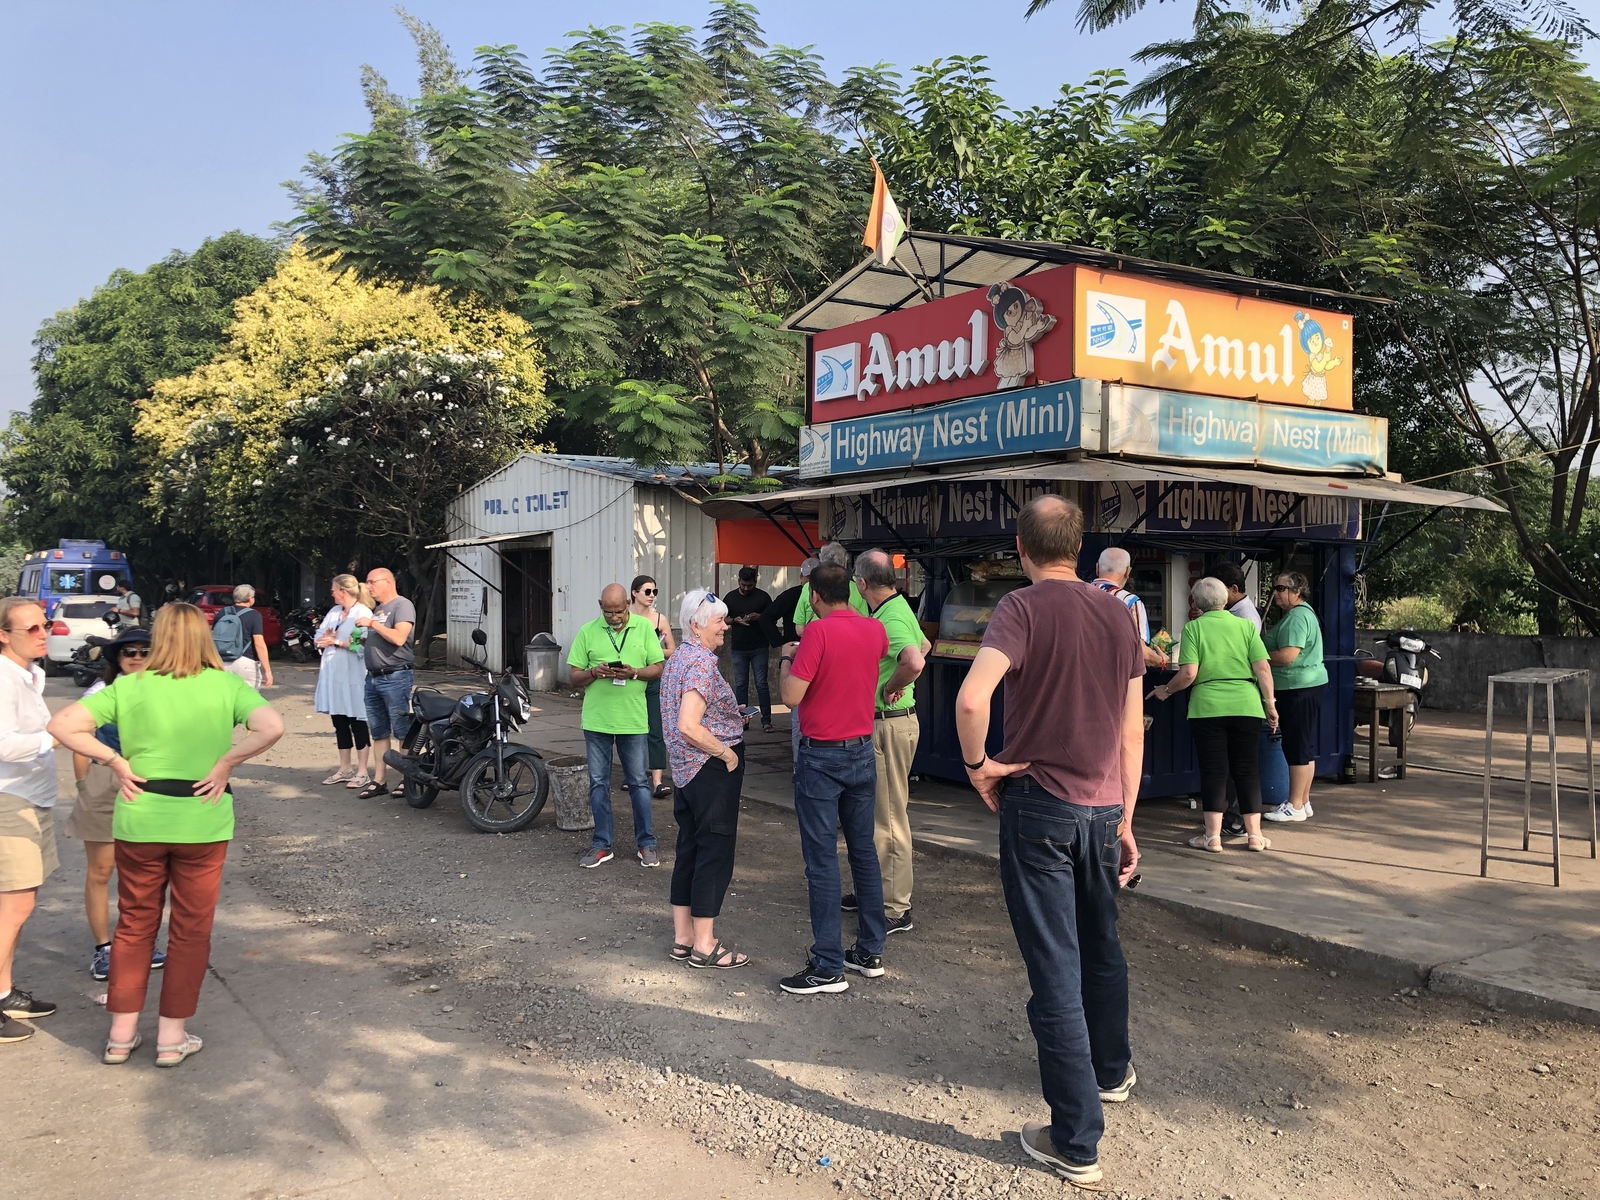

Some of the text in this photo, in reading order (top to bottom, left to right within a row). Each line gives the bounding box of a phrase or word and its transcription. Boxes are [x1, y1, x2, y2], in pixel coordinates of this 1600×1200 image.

[857, 309, 988, 401] Amul
[1152, 299, 1296, 388] Amul
[836, 390, 1074, 466] Highway Nest (Mini)
[1168, 405, 1266, 451] Highway
[1272, 417, 1321, 451] Nest
[870, 486, 944, 533] Highway
[948, 481, 993, 522] Nest
[1158, 481, 1247, 530] Highway
[1252, 486, 1295, 525] Nest
